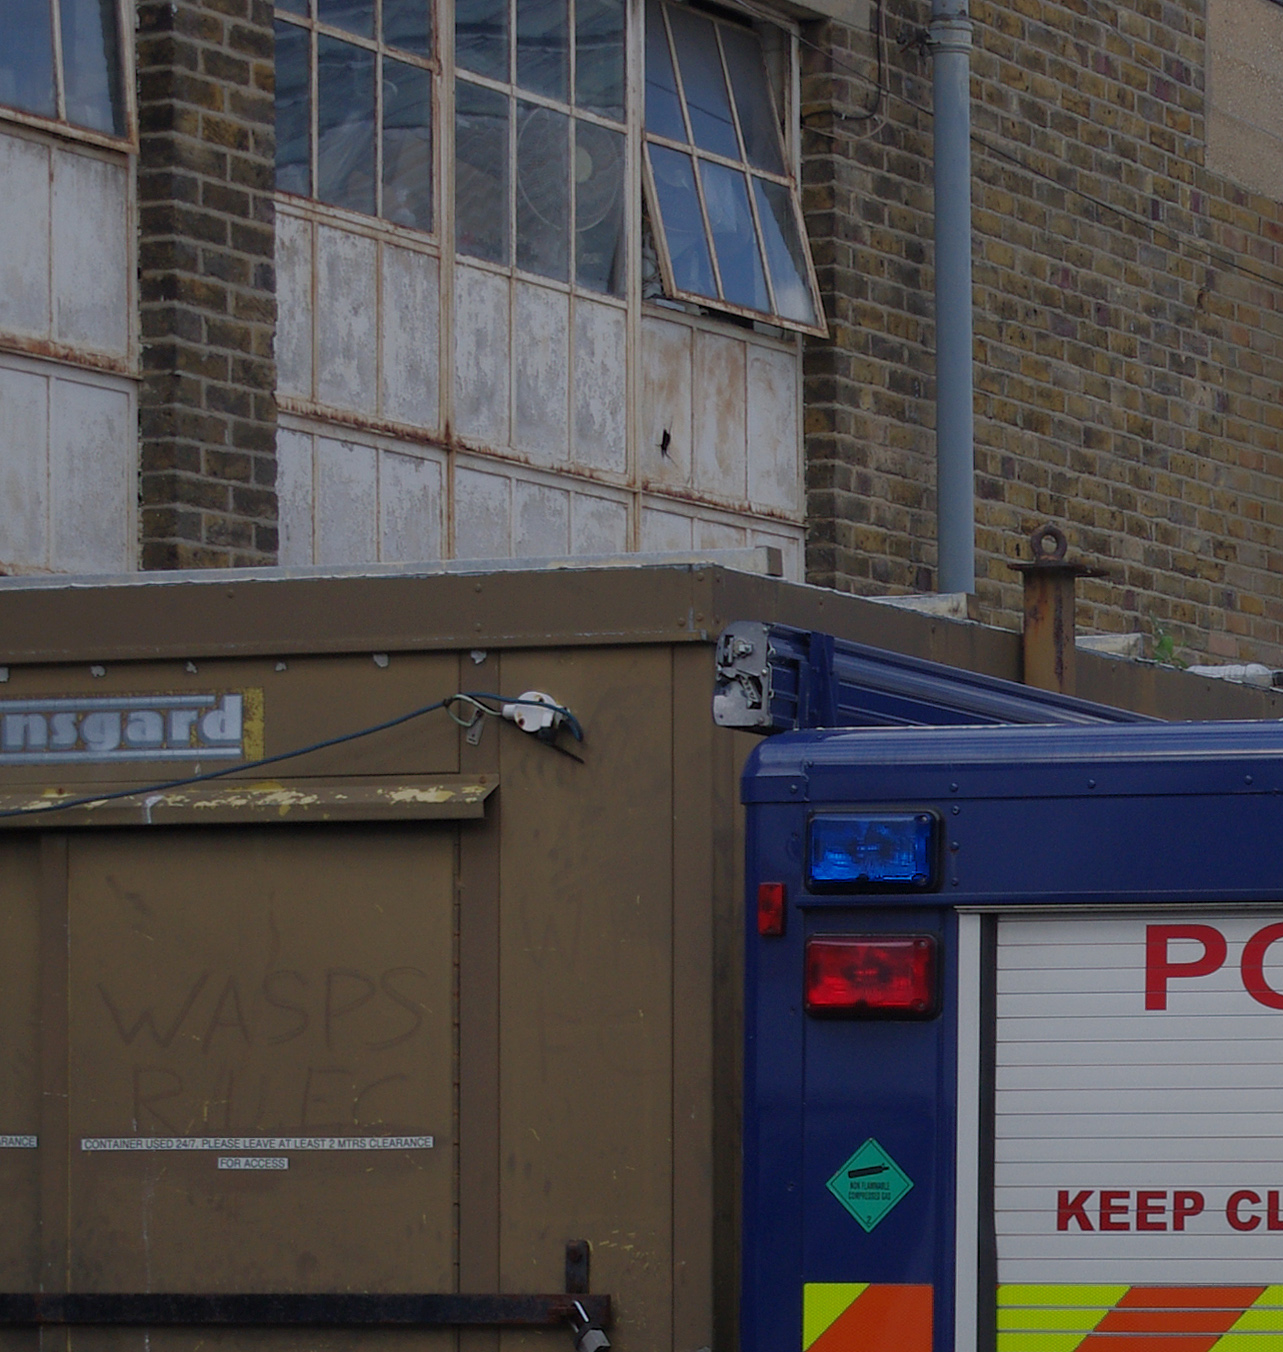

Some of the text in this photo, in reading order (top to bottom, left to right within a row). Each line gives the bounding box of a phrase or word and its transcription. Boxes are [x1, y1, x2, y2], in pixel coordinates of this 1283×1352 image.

[2, 694, 243, 750] nsgard
[95, 965, 428, 1054] WASPS
[0, 1136, 36, 1147] RANCE
[84, 1140, 143, 1149] CONTAINER
[145, 1140, 174, 1149] USED
[201, 1139, 241, 1149] PLEASE
[243, 1139, 276, 1149] LEAVE
[278, 1139, 292, 1148] AT
[294, 1139, 326, 1148] LEAST
[328, 1139, 336, 1148] 2
[338, 1139, 367, 1148] MTRS
[369, 1137, 432, 1148] CLEARANCE
[220, 1158, 285, 1168] FOR ACCESS
[1056, 1190, 1205, 1232] KEEP
